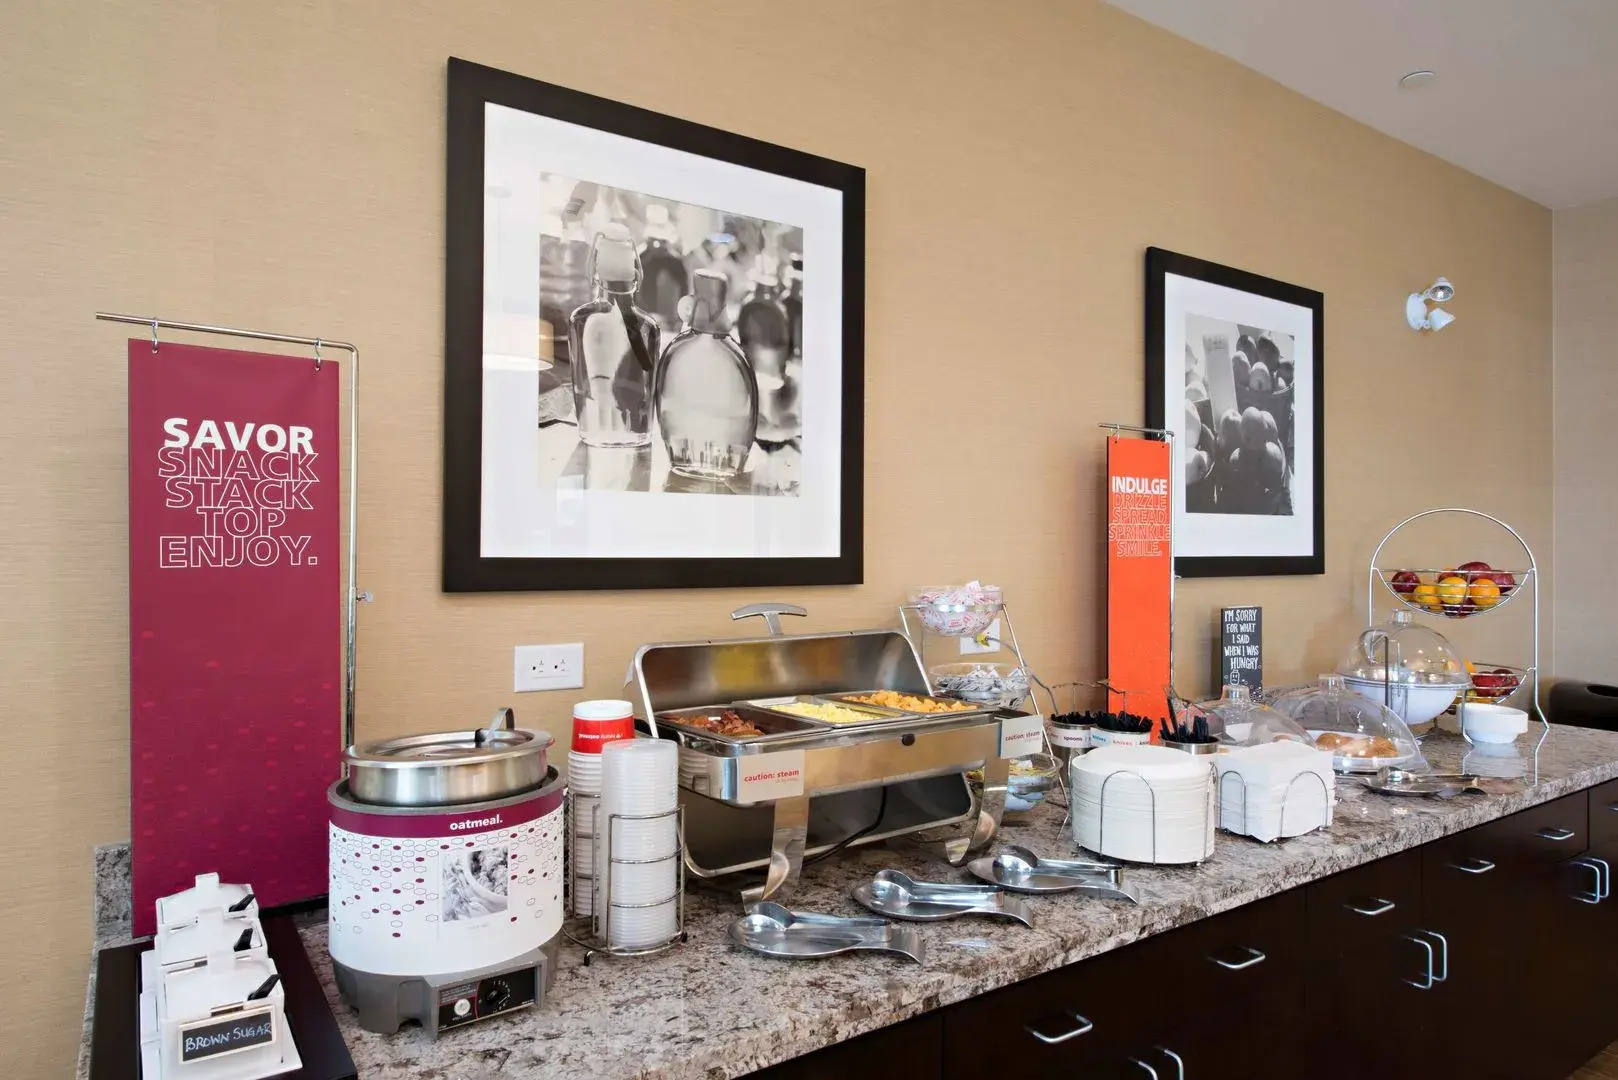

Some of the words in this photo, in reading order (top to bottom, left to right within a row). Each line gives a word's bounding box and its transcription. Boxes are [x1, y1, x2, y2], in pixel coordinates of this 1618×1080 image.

[163, 417, 314, 454] SAVOR
[157, 446, 320, 483] SNACK
[165, 476, 314, 510] STACK
[1111, 475, 1168, 495] INDULGE
[1113, 492, 1167, 510] DRIZZLE
[196, 506, 286, 538] TOP
[1112, 507, 1167, 525] SPREAD
[1108, 523, 1171, 541] SPRINKLE
[159, 535, 318, 568] ENJOY.
[1224, 609, 1234, 622] I'M
[1235, 609, 1258, 622] SORRY
[1226, 623, 1238, 633] FOR
[1239, 623, 1256, 633] WHAT
[1236, 634, 1250, 644] SAID
[1224, 645, 1241, 657] WHEN
[1246, 645, 1260, 656] WAS
[1230, 657, 1259, 670] HUNGRY
[743, 772, 775, 783] caution:
[776, 768, 800, 779] steam
[448, 813, 504, 831] oatmeal.
[184, 1032, 230, 1053] BROWN
[232, 1021, 273, 1040] SUGAR
